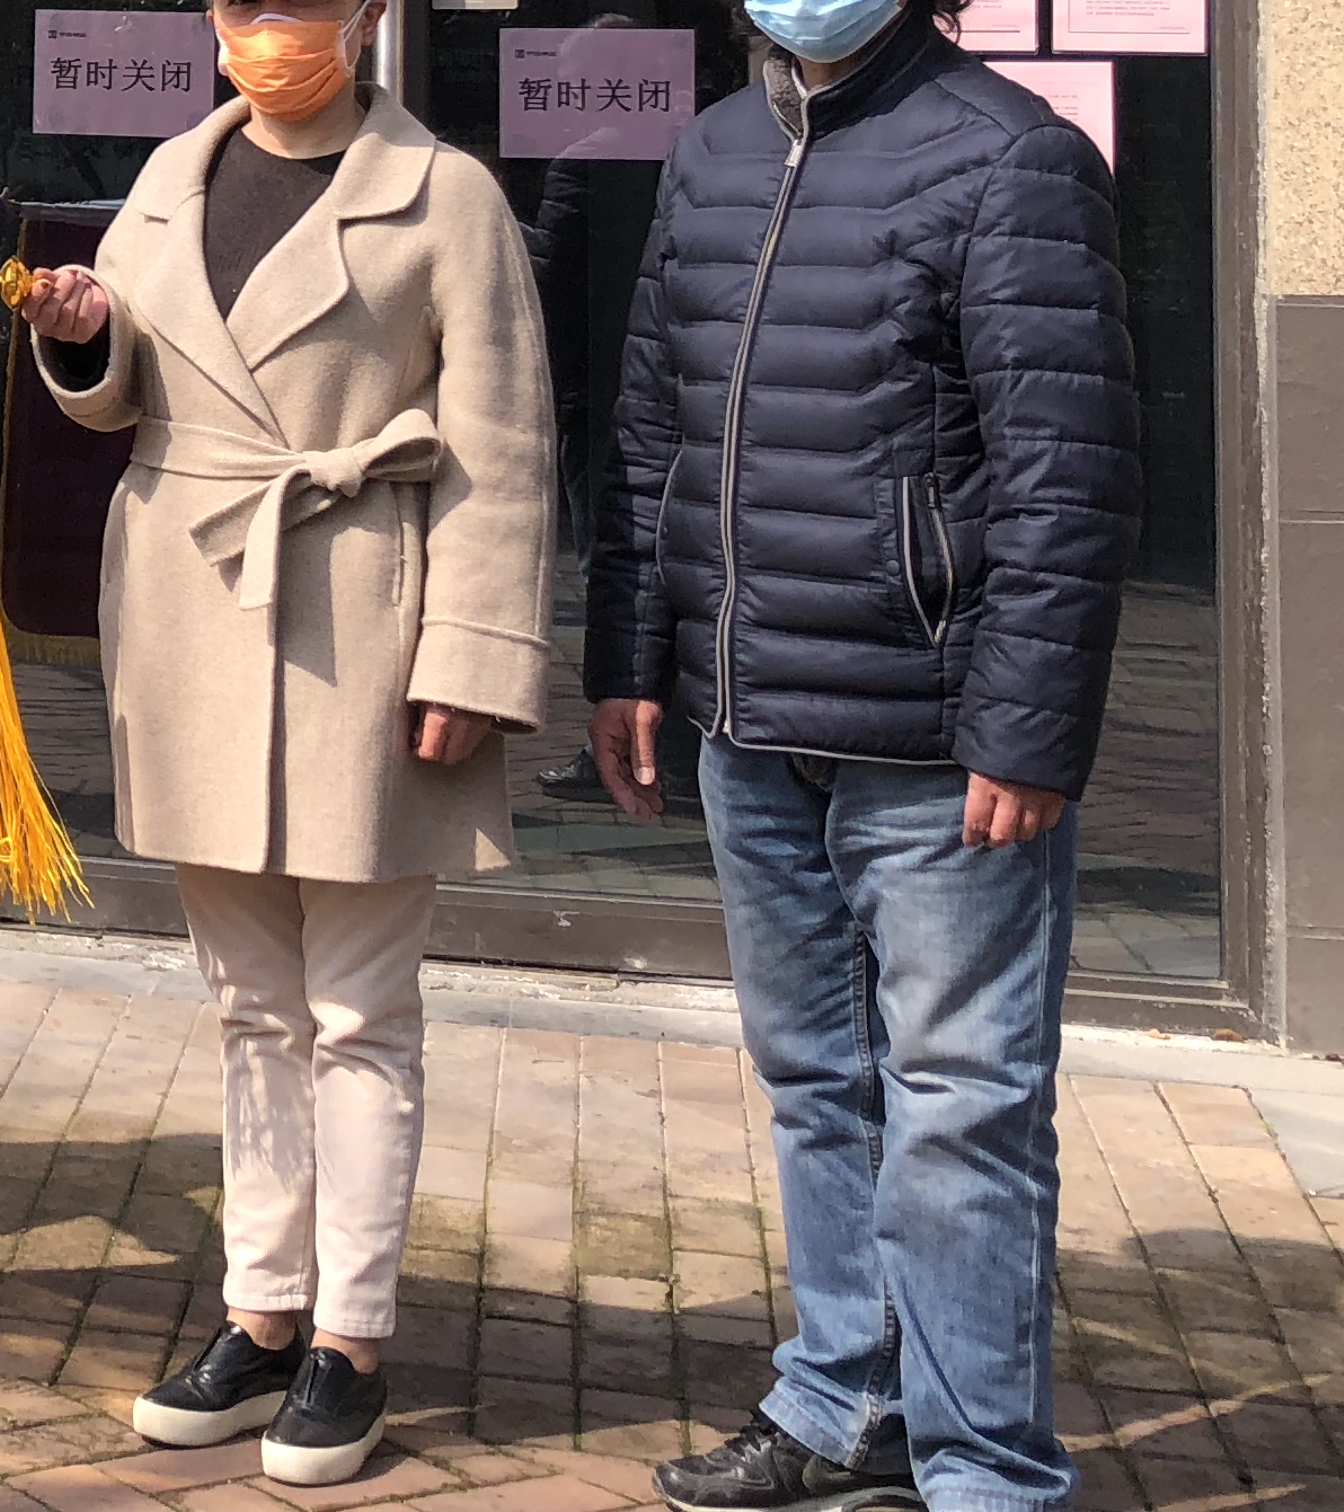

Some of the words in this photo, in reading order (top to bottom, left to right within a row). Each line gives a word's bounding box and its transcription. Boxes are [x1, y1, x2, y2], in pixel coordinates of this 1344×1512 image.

[50, 56, 193, 93] 暂时关闭
[518, 77, 672, 113] 暂时关闭
